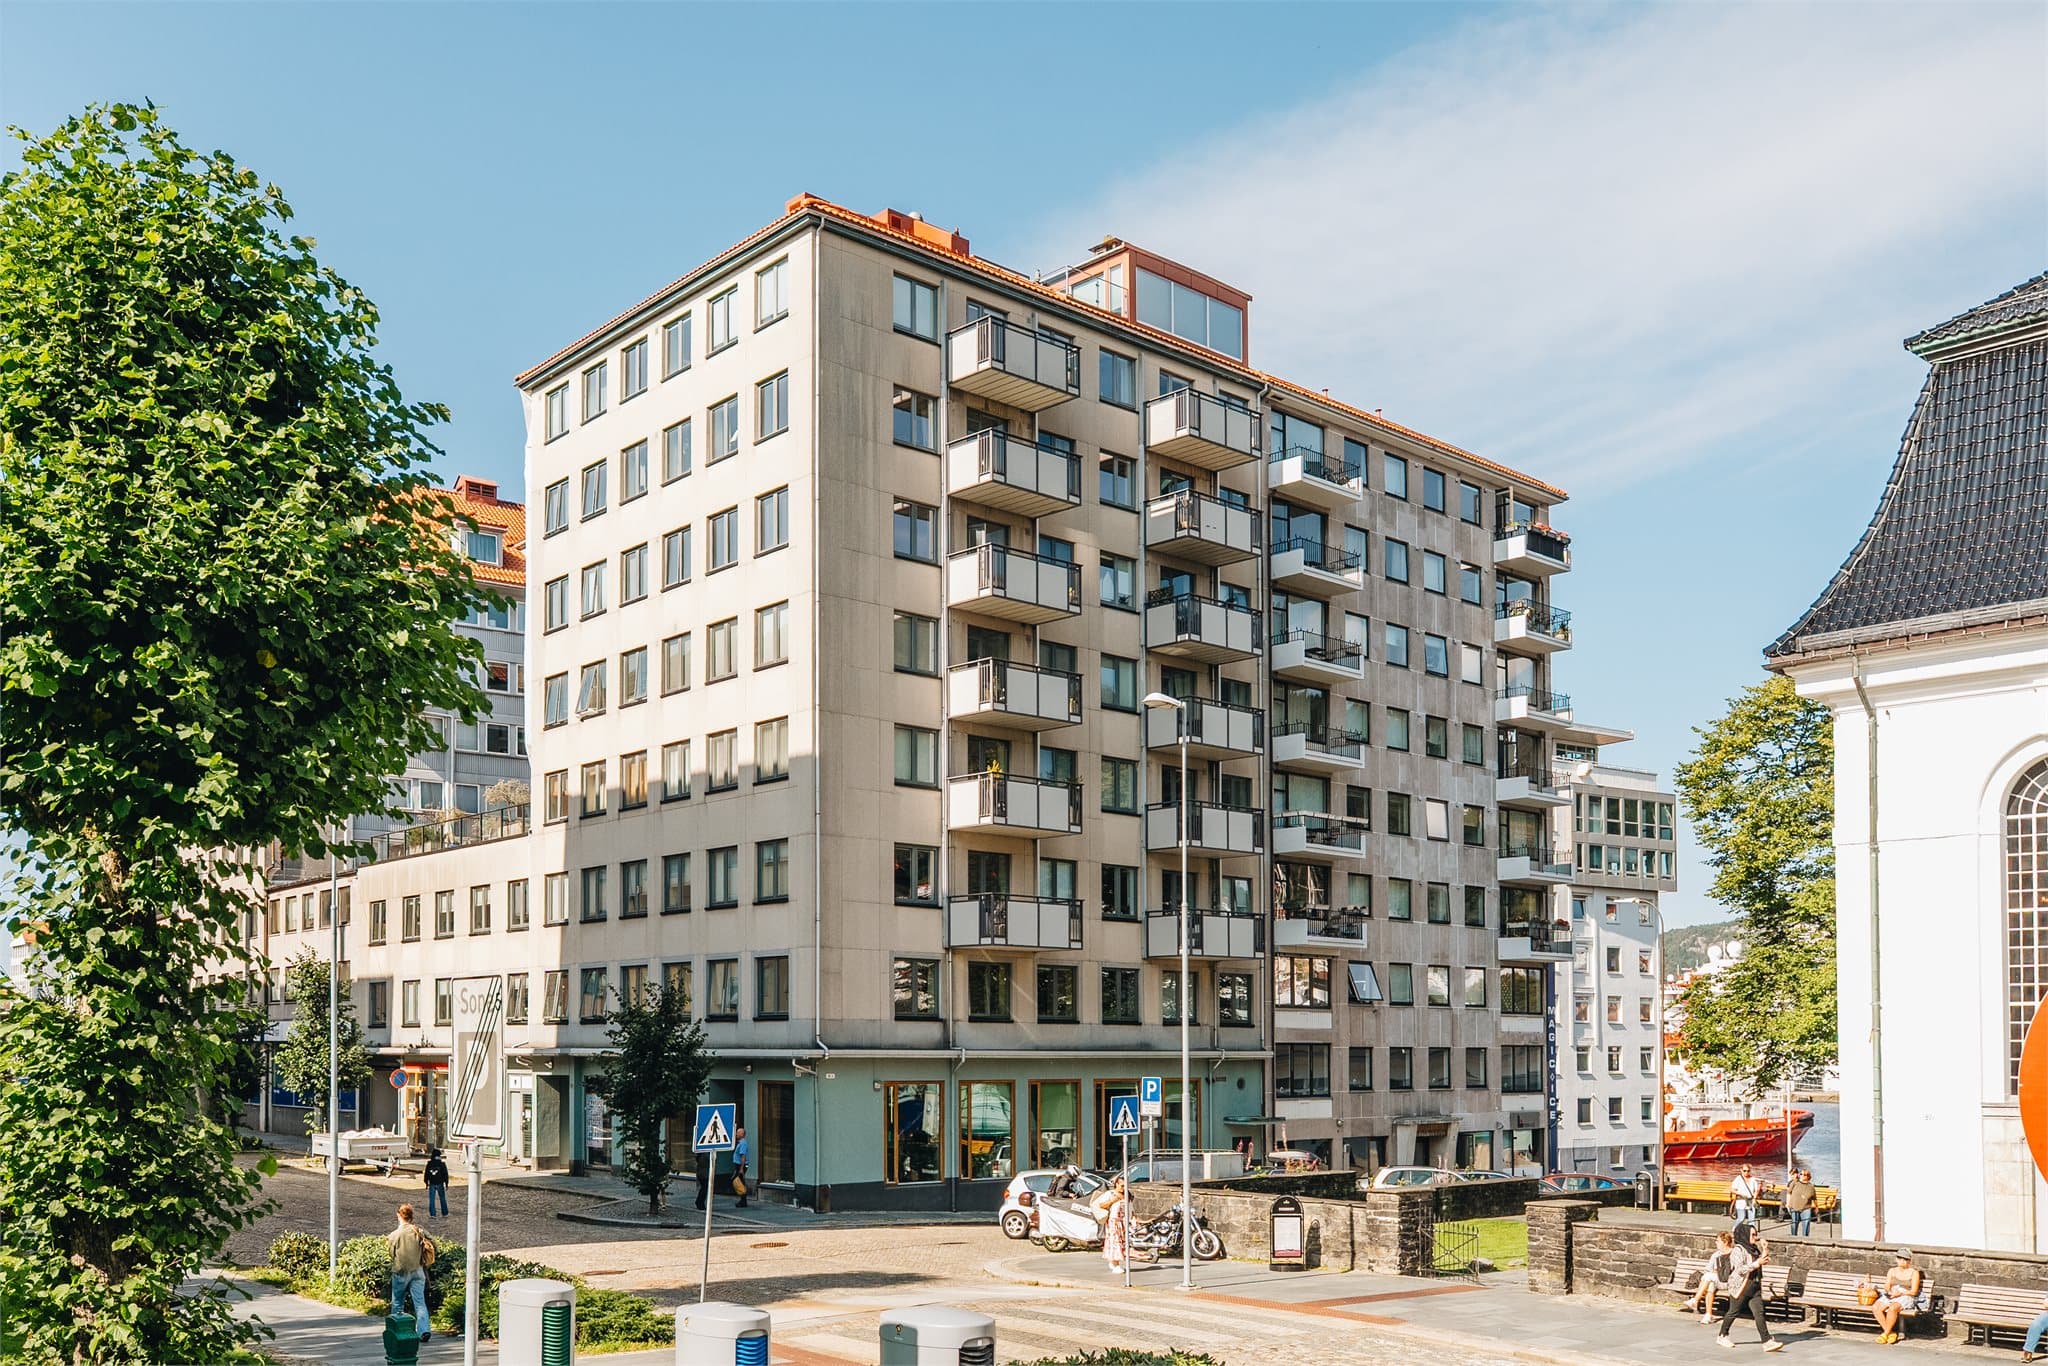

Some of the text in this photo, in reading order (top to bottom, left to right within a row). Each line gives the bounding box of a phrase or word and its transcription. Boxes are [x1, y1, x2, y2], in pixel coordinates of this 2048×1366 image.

[461, 987, 496, 1014] Son
[1548, 1006, 1556, 1068] MAGIC
[1147, 1081, 1157, 1099] P
